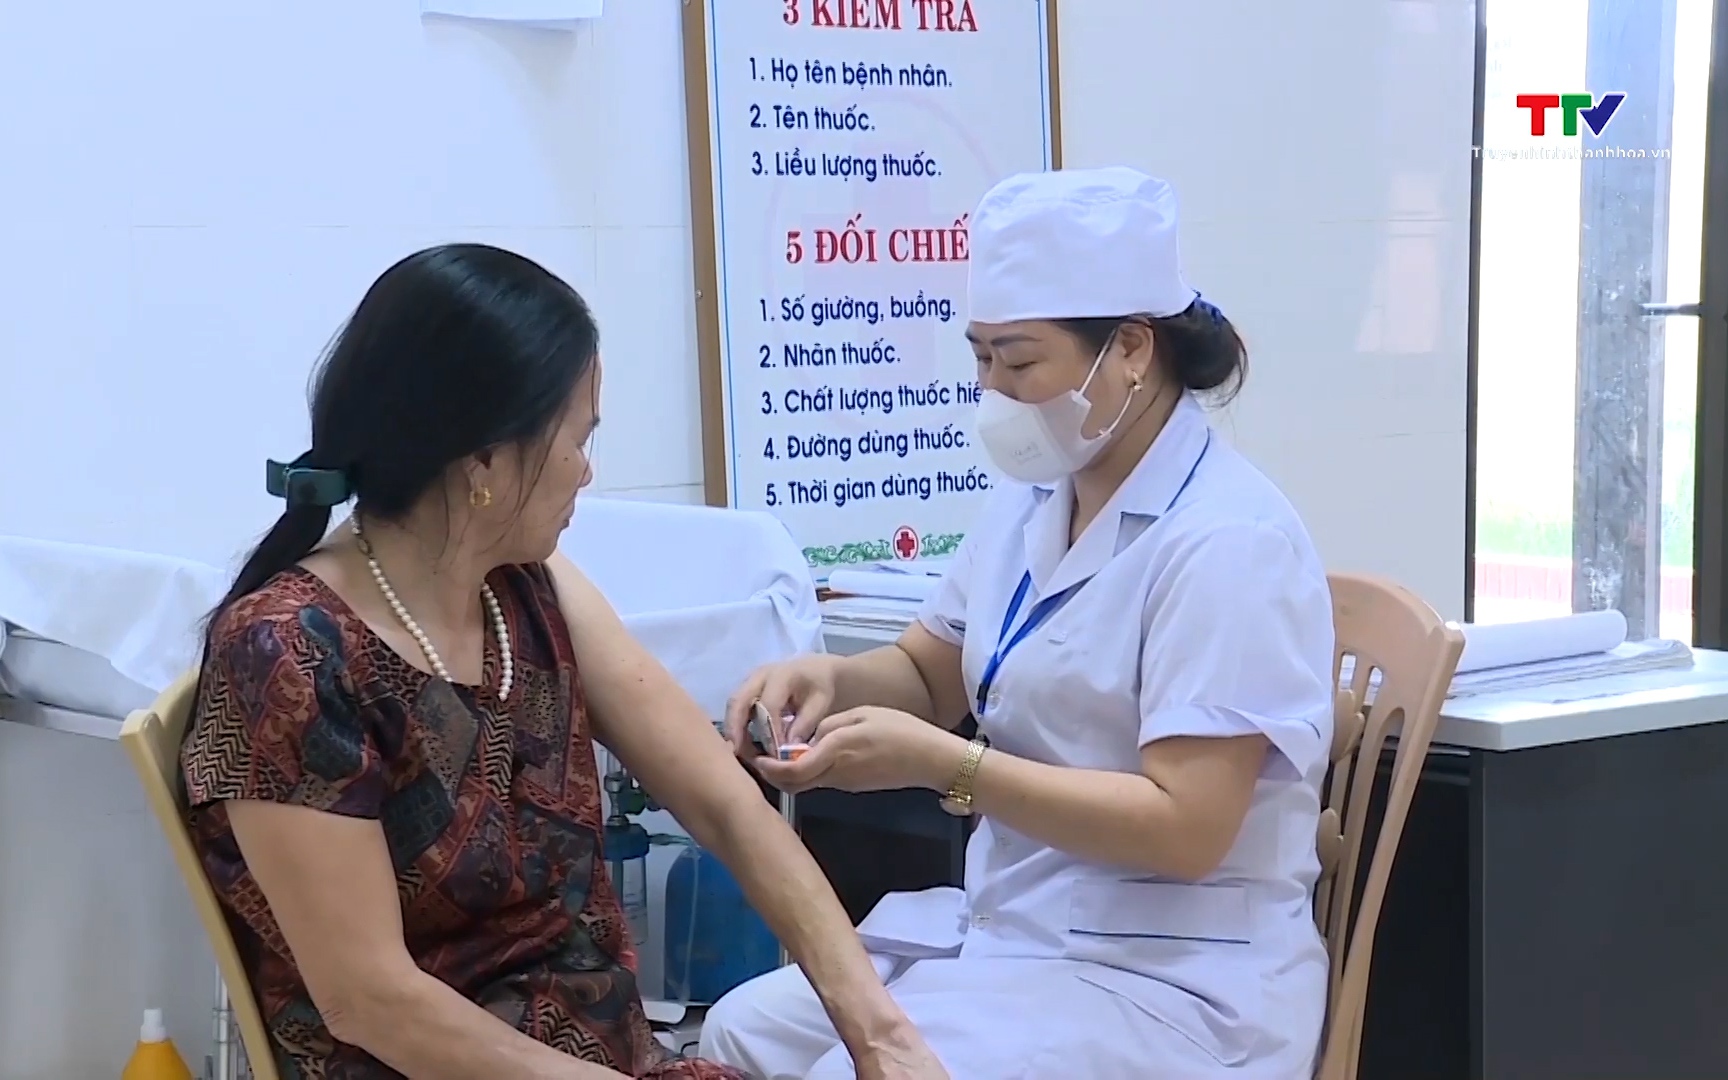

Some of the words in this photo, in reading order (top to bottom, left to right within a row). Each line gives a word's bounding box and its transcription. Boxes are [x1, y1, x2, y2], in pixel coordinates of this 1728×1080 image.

[782, 0, 800, 26] 3
[911, 0, 979, 33] TRA
[749, 56, 765, 82] 1.
[771, 57, 799, 89] Họ
[804, 59, 837, 85] tên
[841, 61, 893, 90] bệnh
[898, 63, 953, 88] nhân.
[749, 103, 767, 129] 2.
[772, 104, 809, 130] Tên
[813, 103, 876, 132] thuốc.
[751, 150, 769, 176] 3.
[775, 146, 817, 177] Liều
[821, 153, 878, 183] lượng
[881, 150, 942, 178] thuốc.
[785, 230, 803, 265] 5
[813, 212, 878, 264] ĐỐI
[759, 298, 776, 322] 1.
[780, 293, 806, 322] Số
[810, 296, 885, 327] giường,
[890, 289, 956, 323] buồng.
[759, 344, 777, 369] 2.
[783, 342, 837, 368] Nhãn
[841, 337, 901, 365] thuốc.
[761, 390, 778, 415] 3.
[784, 384, 834, 414] Chất
[839, 387, 894, 416] lượng
[897, 379, 951, 408] thuốc
[763, 437, 780, 460] 4.
[786, 433, 852, 463] Đường
[857, 429, 909, 459] dùng
[913, 423, 970, 450] thuốc.
[765, 482, 783, 507] 5.
[787, 479, 828, 505] Thời
[833, 478, 876, 508] gian
[881, 473, 931, 501] dùng
[936, 465, 994, 494] thuốc.
